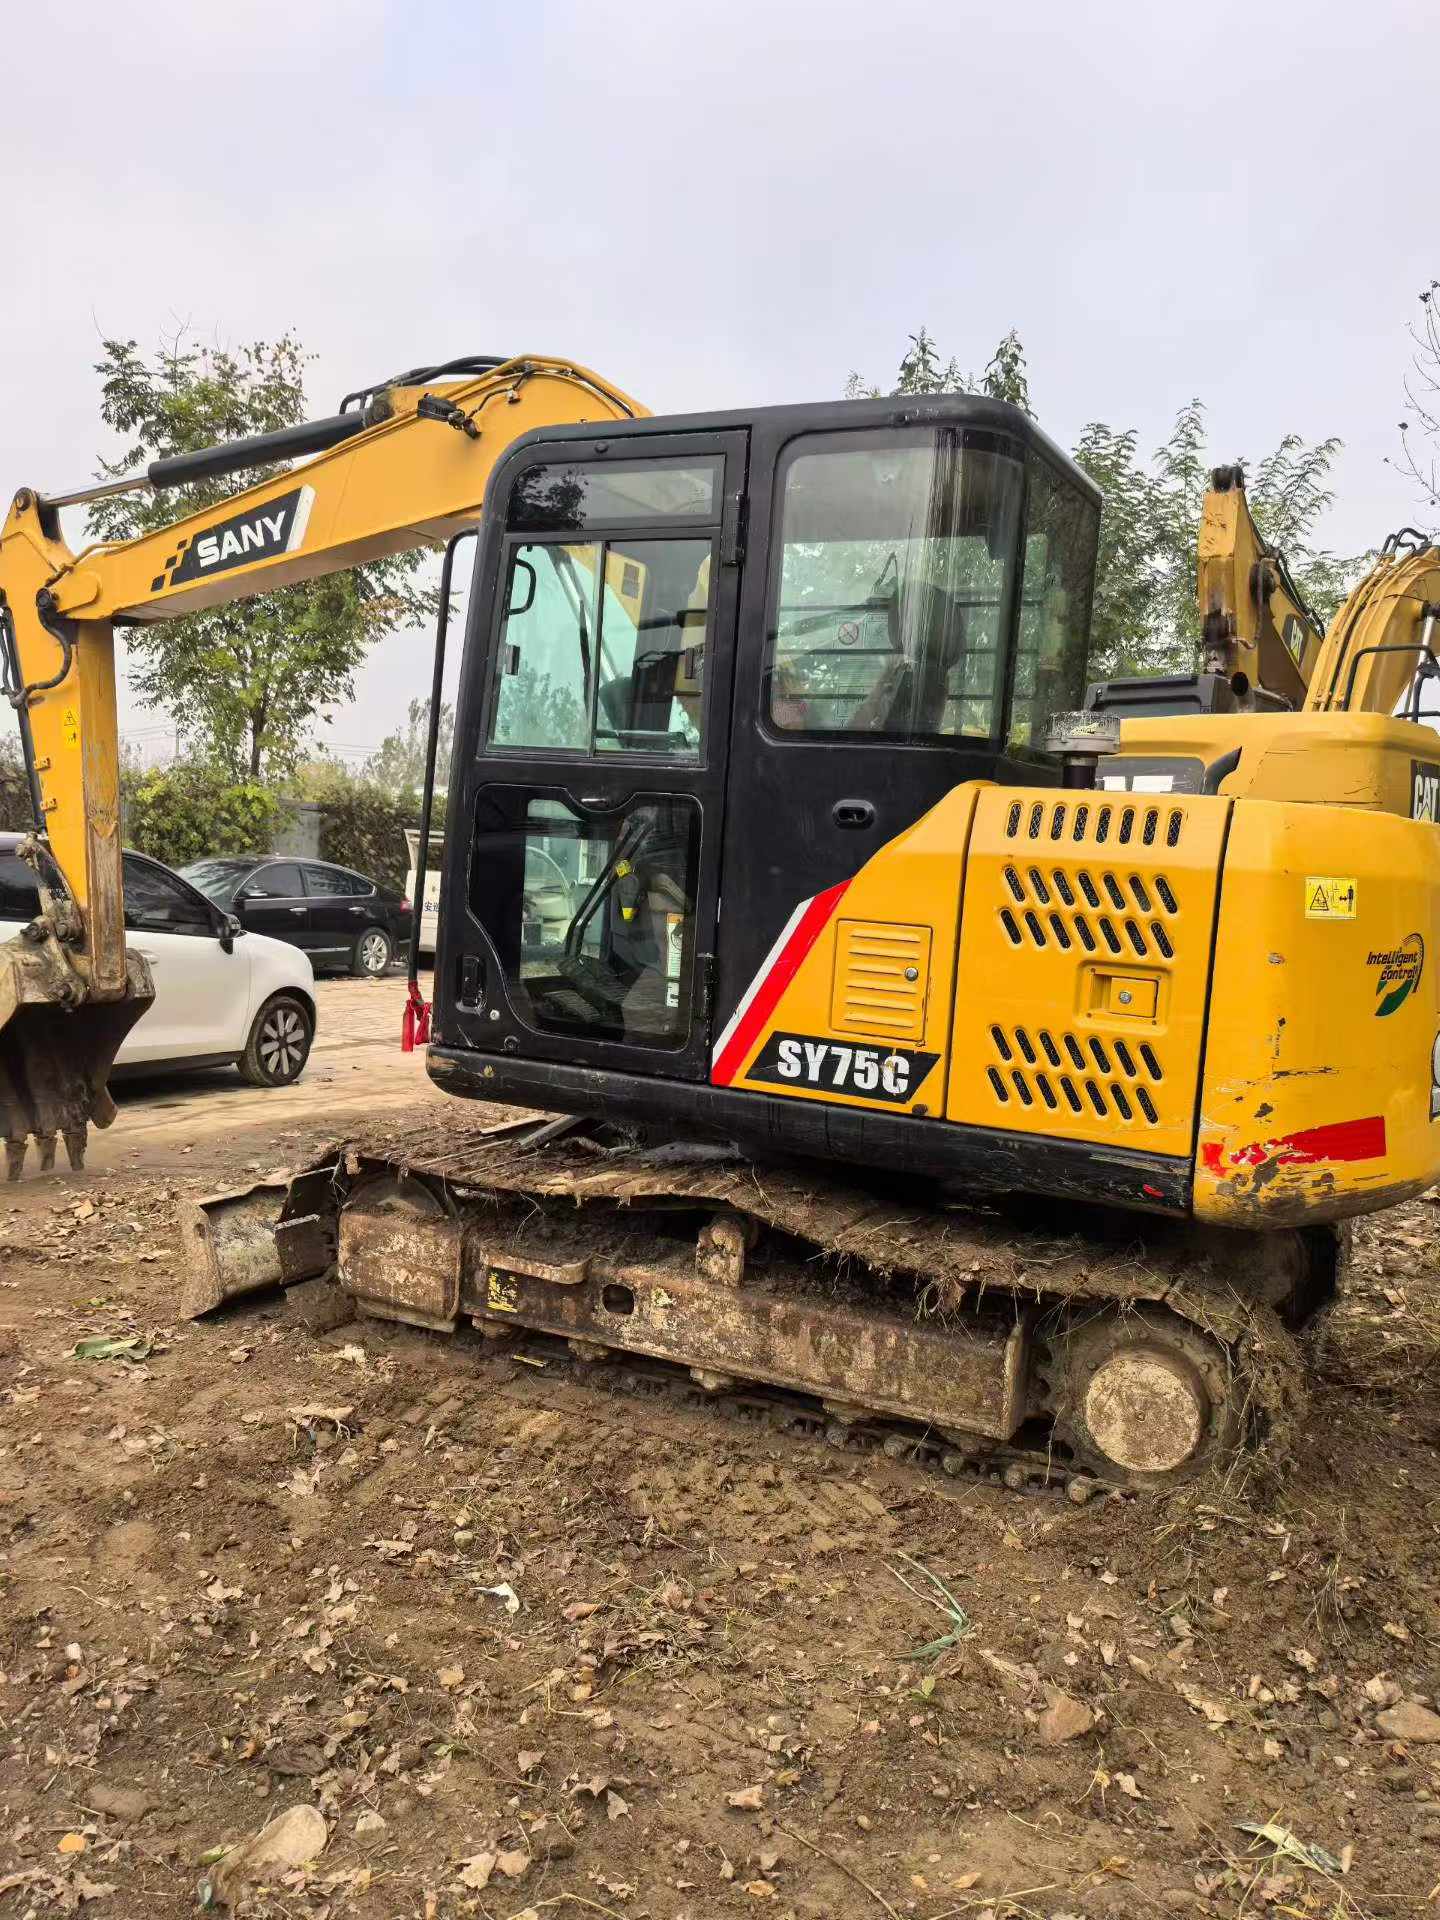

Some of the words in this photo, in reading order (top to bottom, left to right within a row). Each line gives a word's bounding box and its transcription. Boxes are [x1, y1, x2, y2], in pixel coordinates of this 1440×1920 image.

[197, 510, 286, 568] SANY
[1413, 774, 1439, 824] CAT
[1366, 947, 1418, 967] Intelligent
[777, 1039, 910, 1094] SY75C
